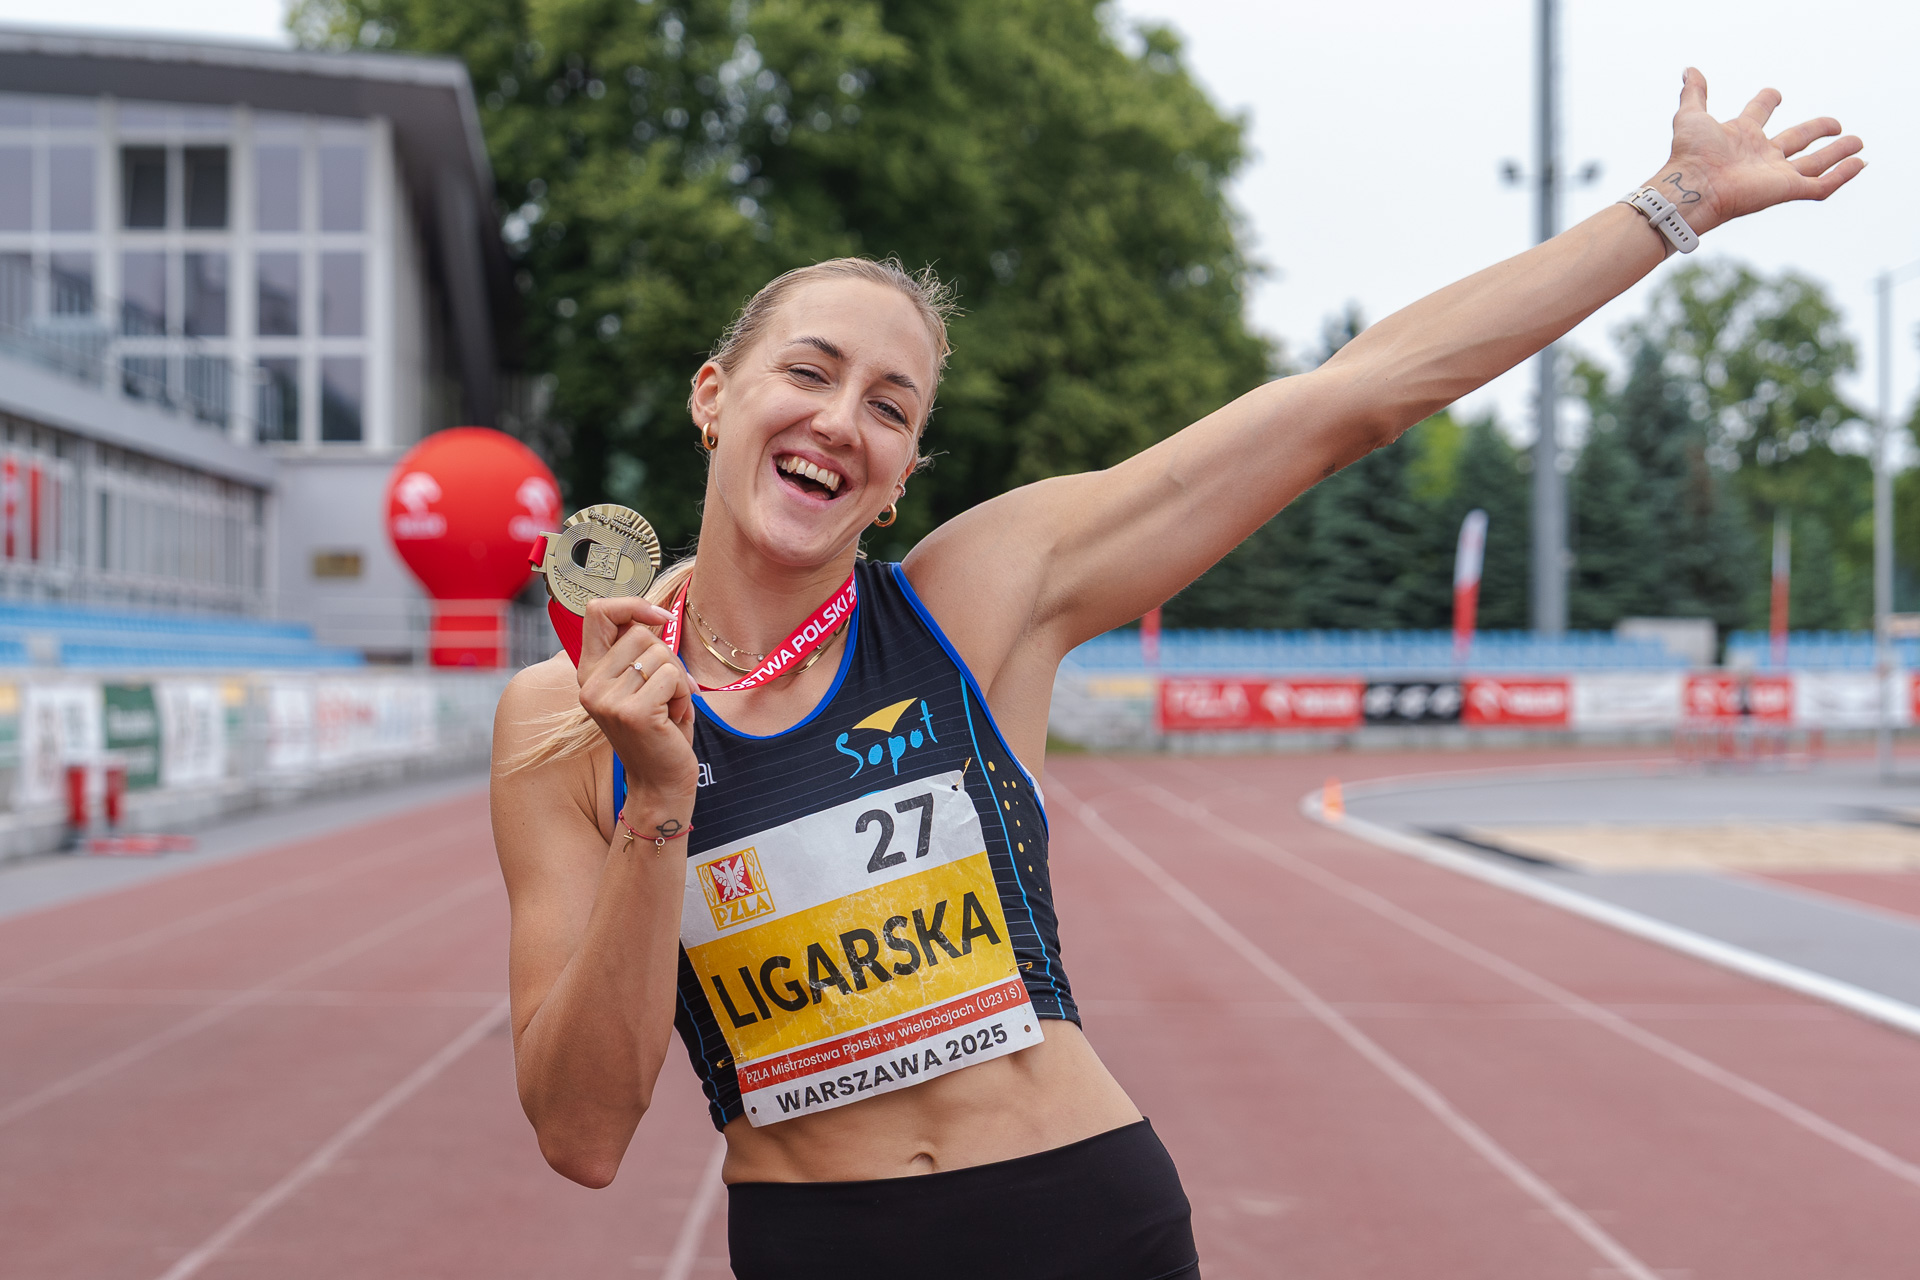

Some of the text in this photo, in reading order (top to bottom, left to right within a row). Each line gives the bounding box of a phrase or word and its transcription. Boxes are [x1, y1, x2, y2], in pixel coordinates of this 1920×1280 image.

[613, 513, 632, 526] 2025
[791, 594, 849, 653] POLSKI
[835, 700, 939, 779] Sopot
[855, 792, 935, 874] 27
[714, 894, 772, 926] PZLA
[711, 891, 1002, 1029] LIGARSKA
[746, 1068, 770, 1084] PZLA
[771, 1049, 841, 1077] Mistrzostwa
[842, 1033, 882, 1056] Polski
[883, 1031, 896, 1043] w
[897, 1003, 975, 1037] wielobojach
[976, 991, 1003, 1013] (U23
[1003, 989, 1009, 1001] i
[776, 1023, 1008, 1114] WARSZAWA 2025
